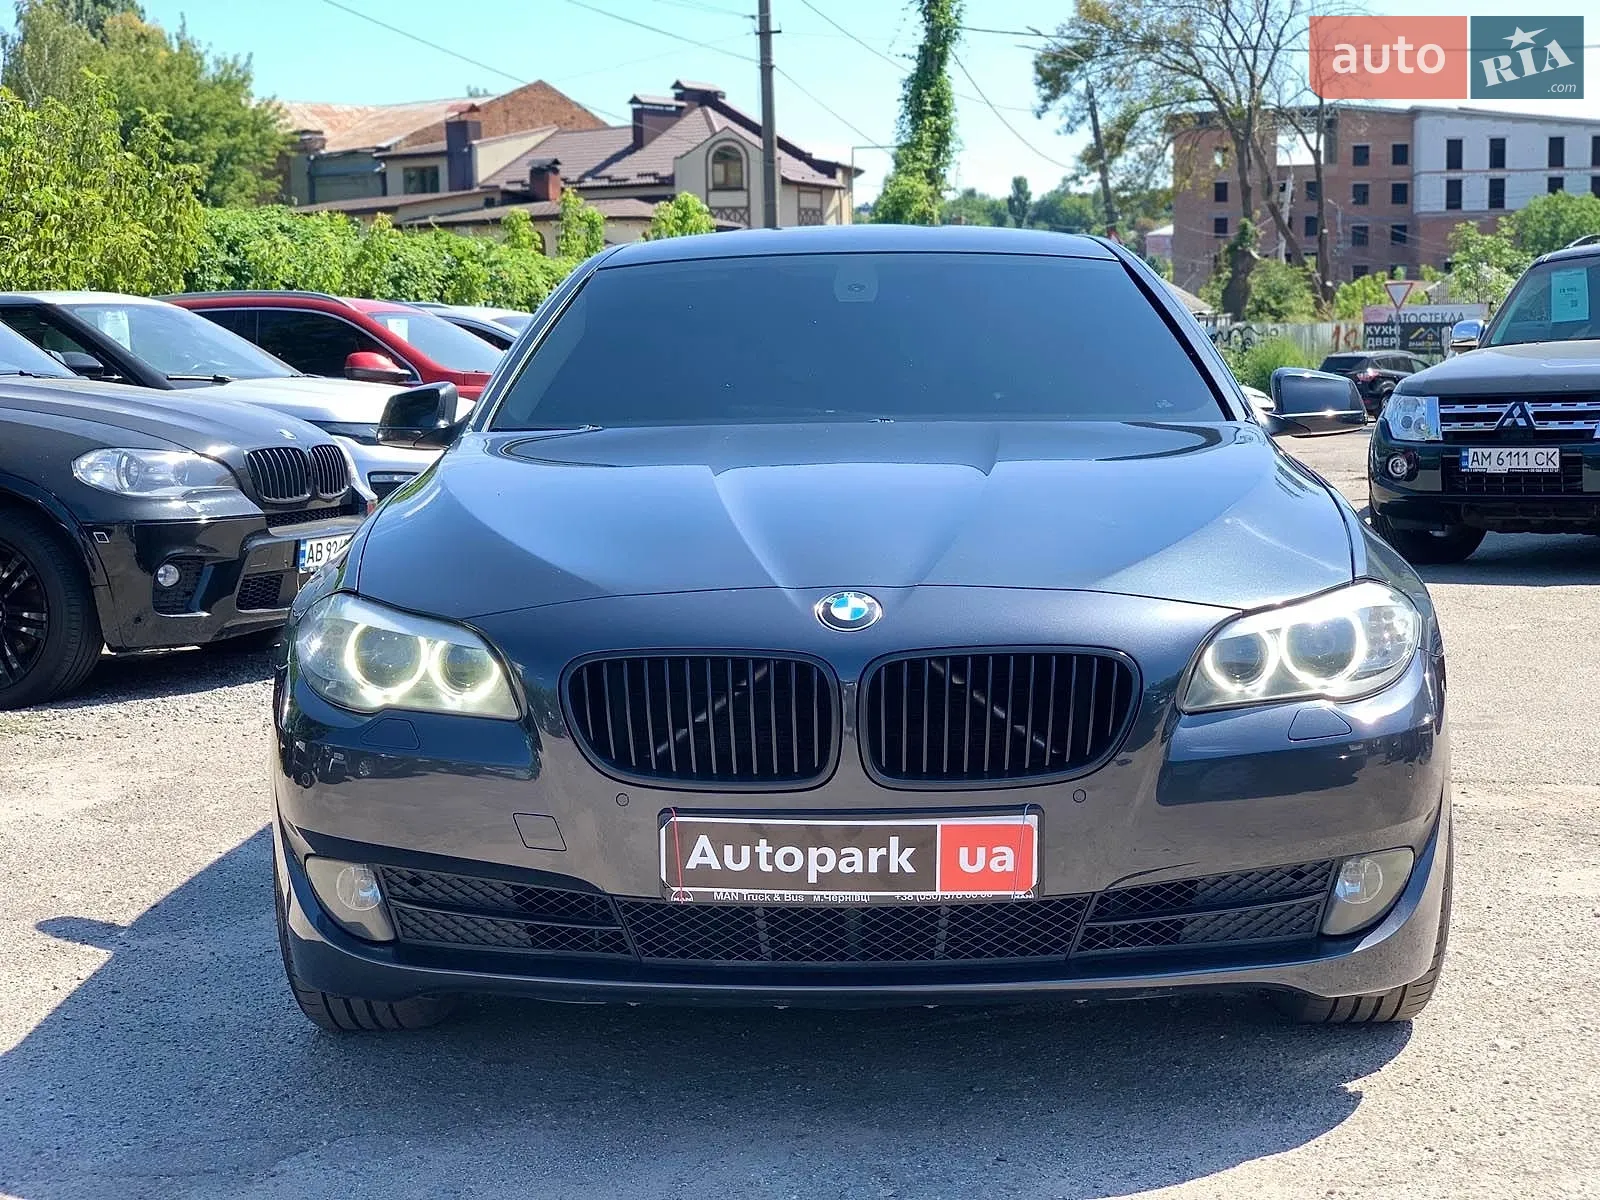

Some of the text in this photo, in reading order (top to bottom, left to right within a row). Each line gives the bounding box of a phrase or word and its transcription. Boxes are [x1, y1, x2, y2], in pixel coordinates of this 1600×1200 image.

[1470, 451, 1557, 466] AM 6111 CK
[306, 543, 323, 564] AB
[685, 834, 1015, 883] Autopark ua
[713, 891, 739, 900] MAN
[742, 891, 771, 901] Truck
[784, 892, 804, 902] Bus
